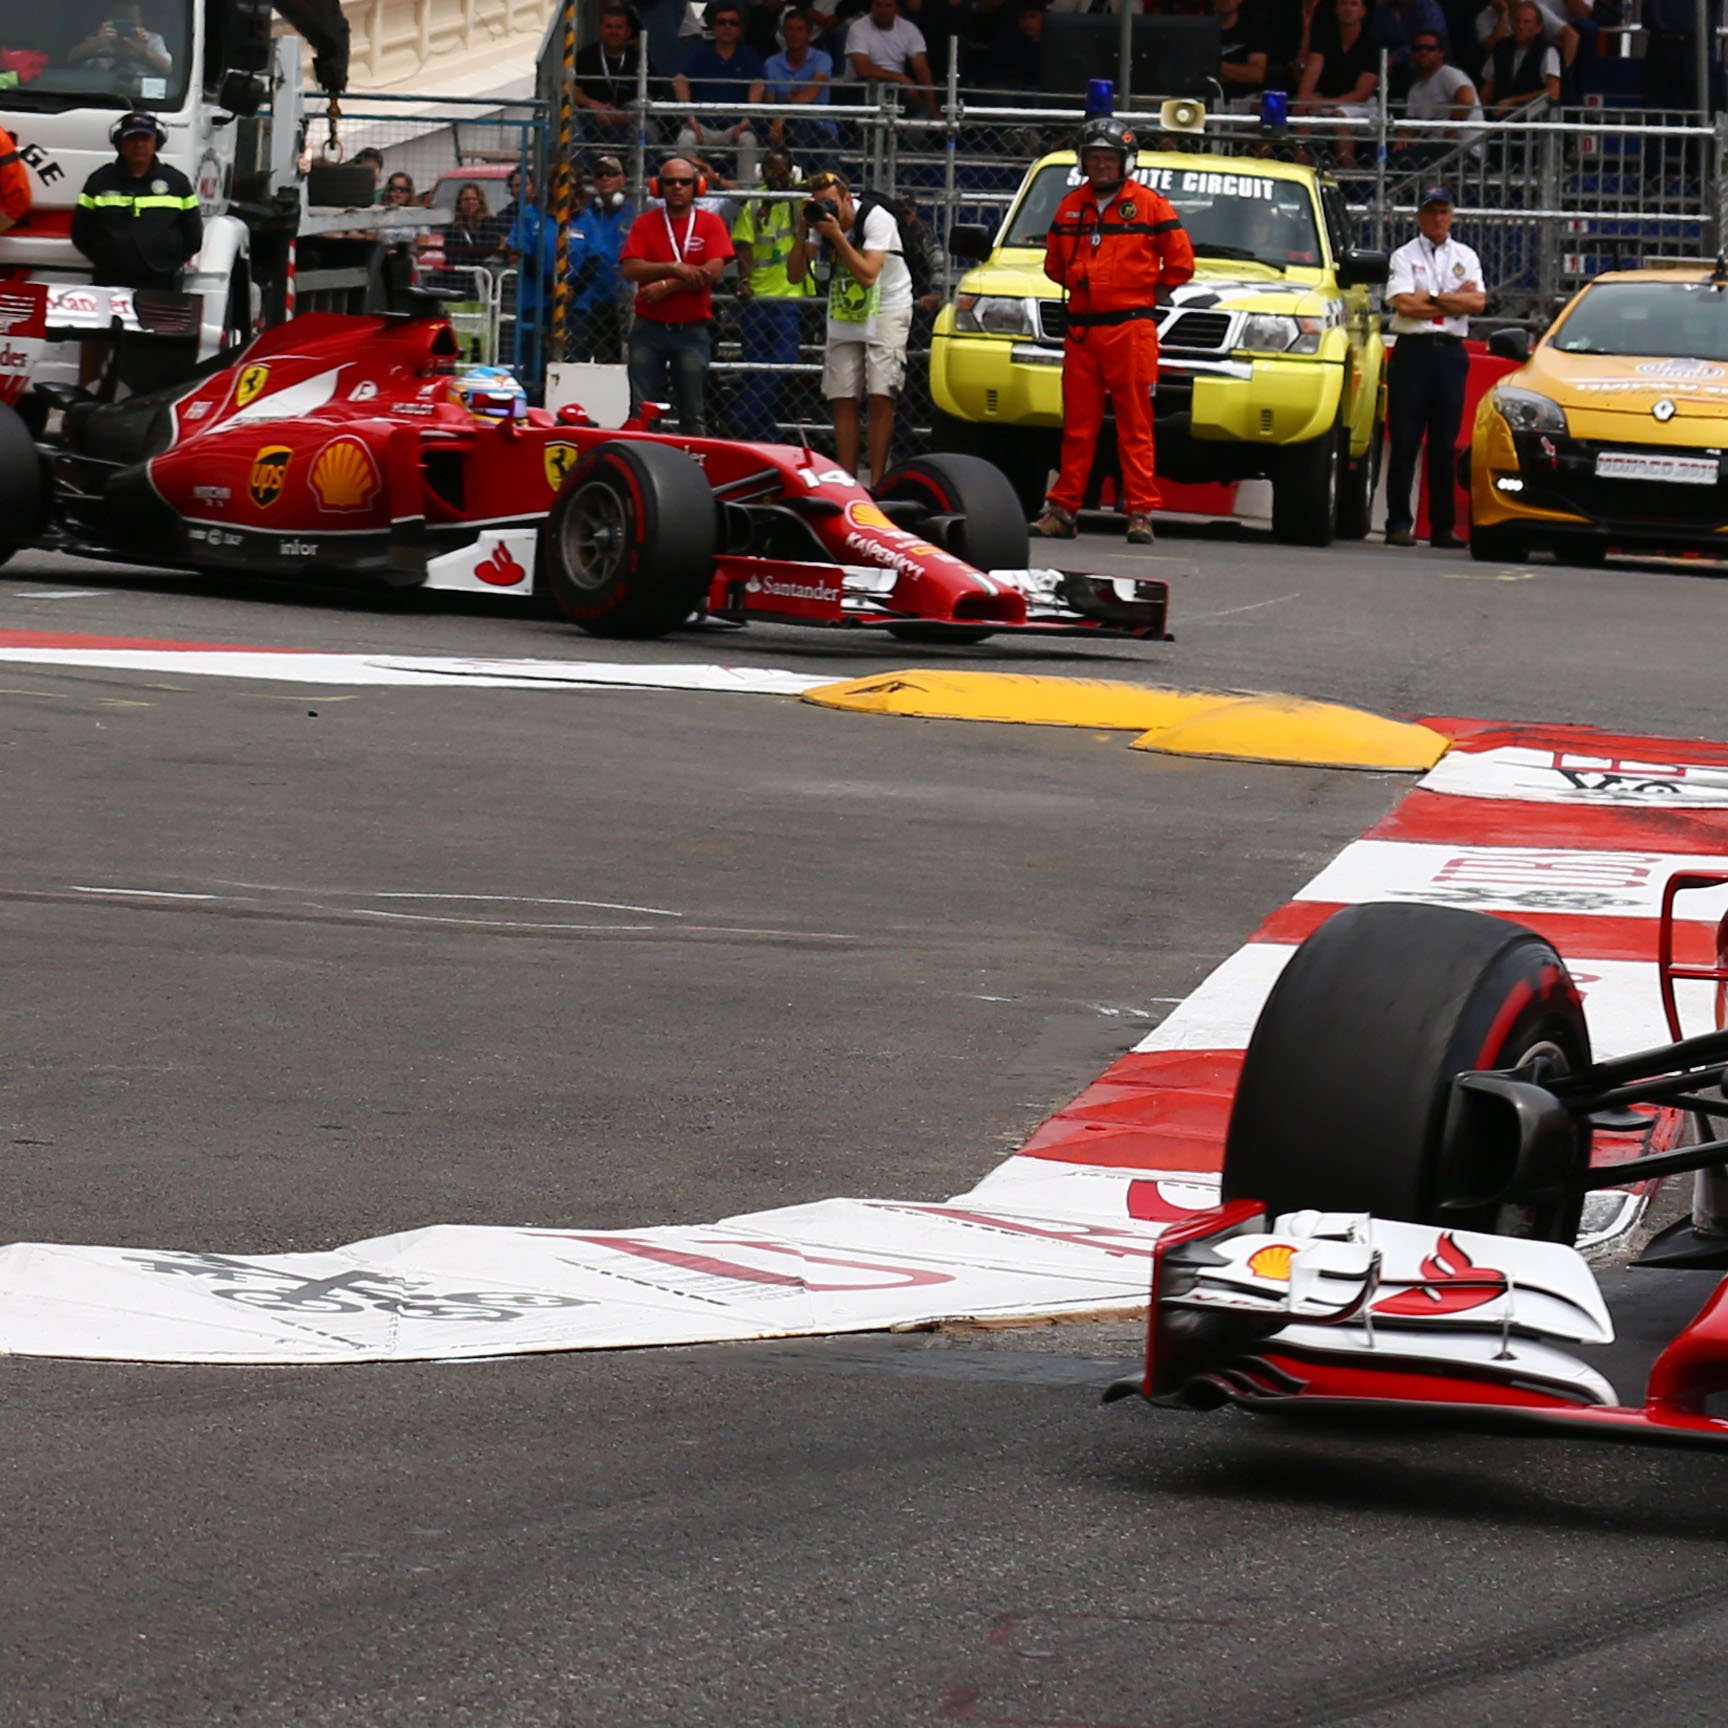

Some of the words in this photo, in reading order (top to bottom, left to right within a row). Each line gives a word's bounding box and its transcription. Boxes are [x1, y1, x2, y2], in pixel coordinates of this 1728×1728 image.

[1182, 171, 1275, 201] CIRCUIT
[253, 464, 286, 499] ups
[797, 468, 857, 489] 14
[762, 575, 841, 602] Santander
